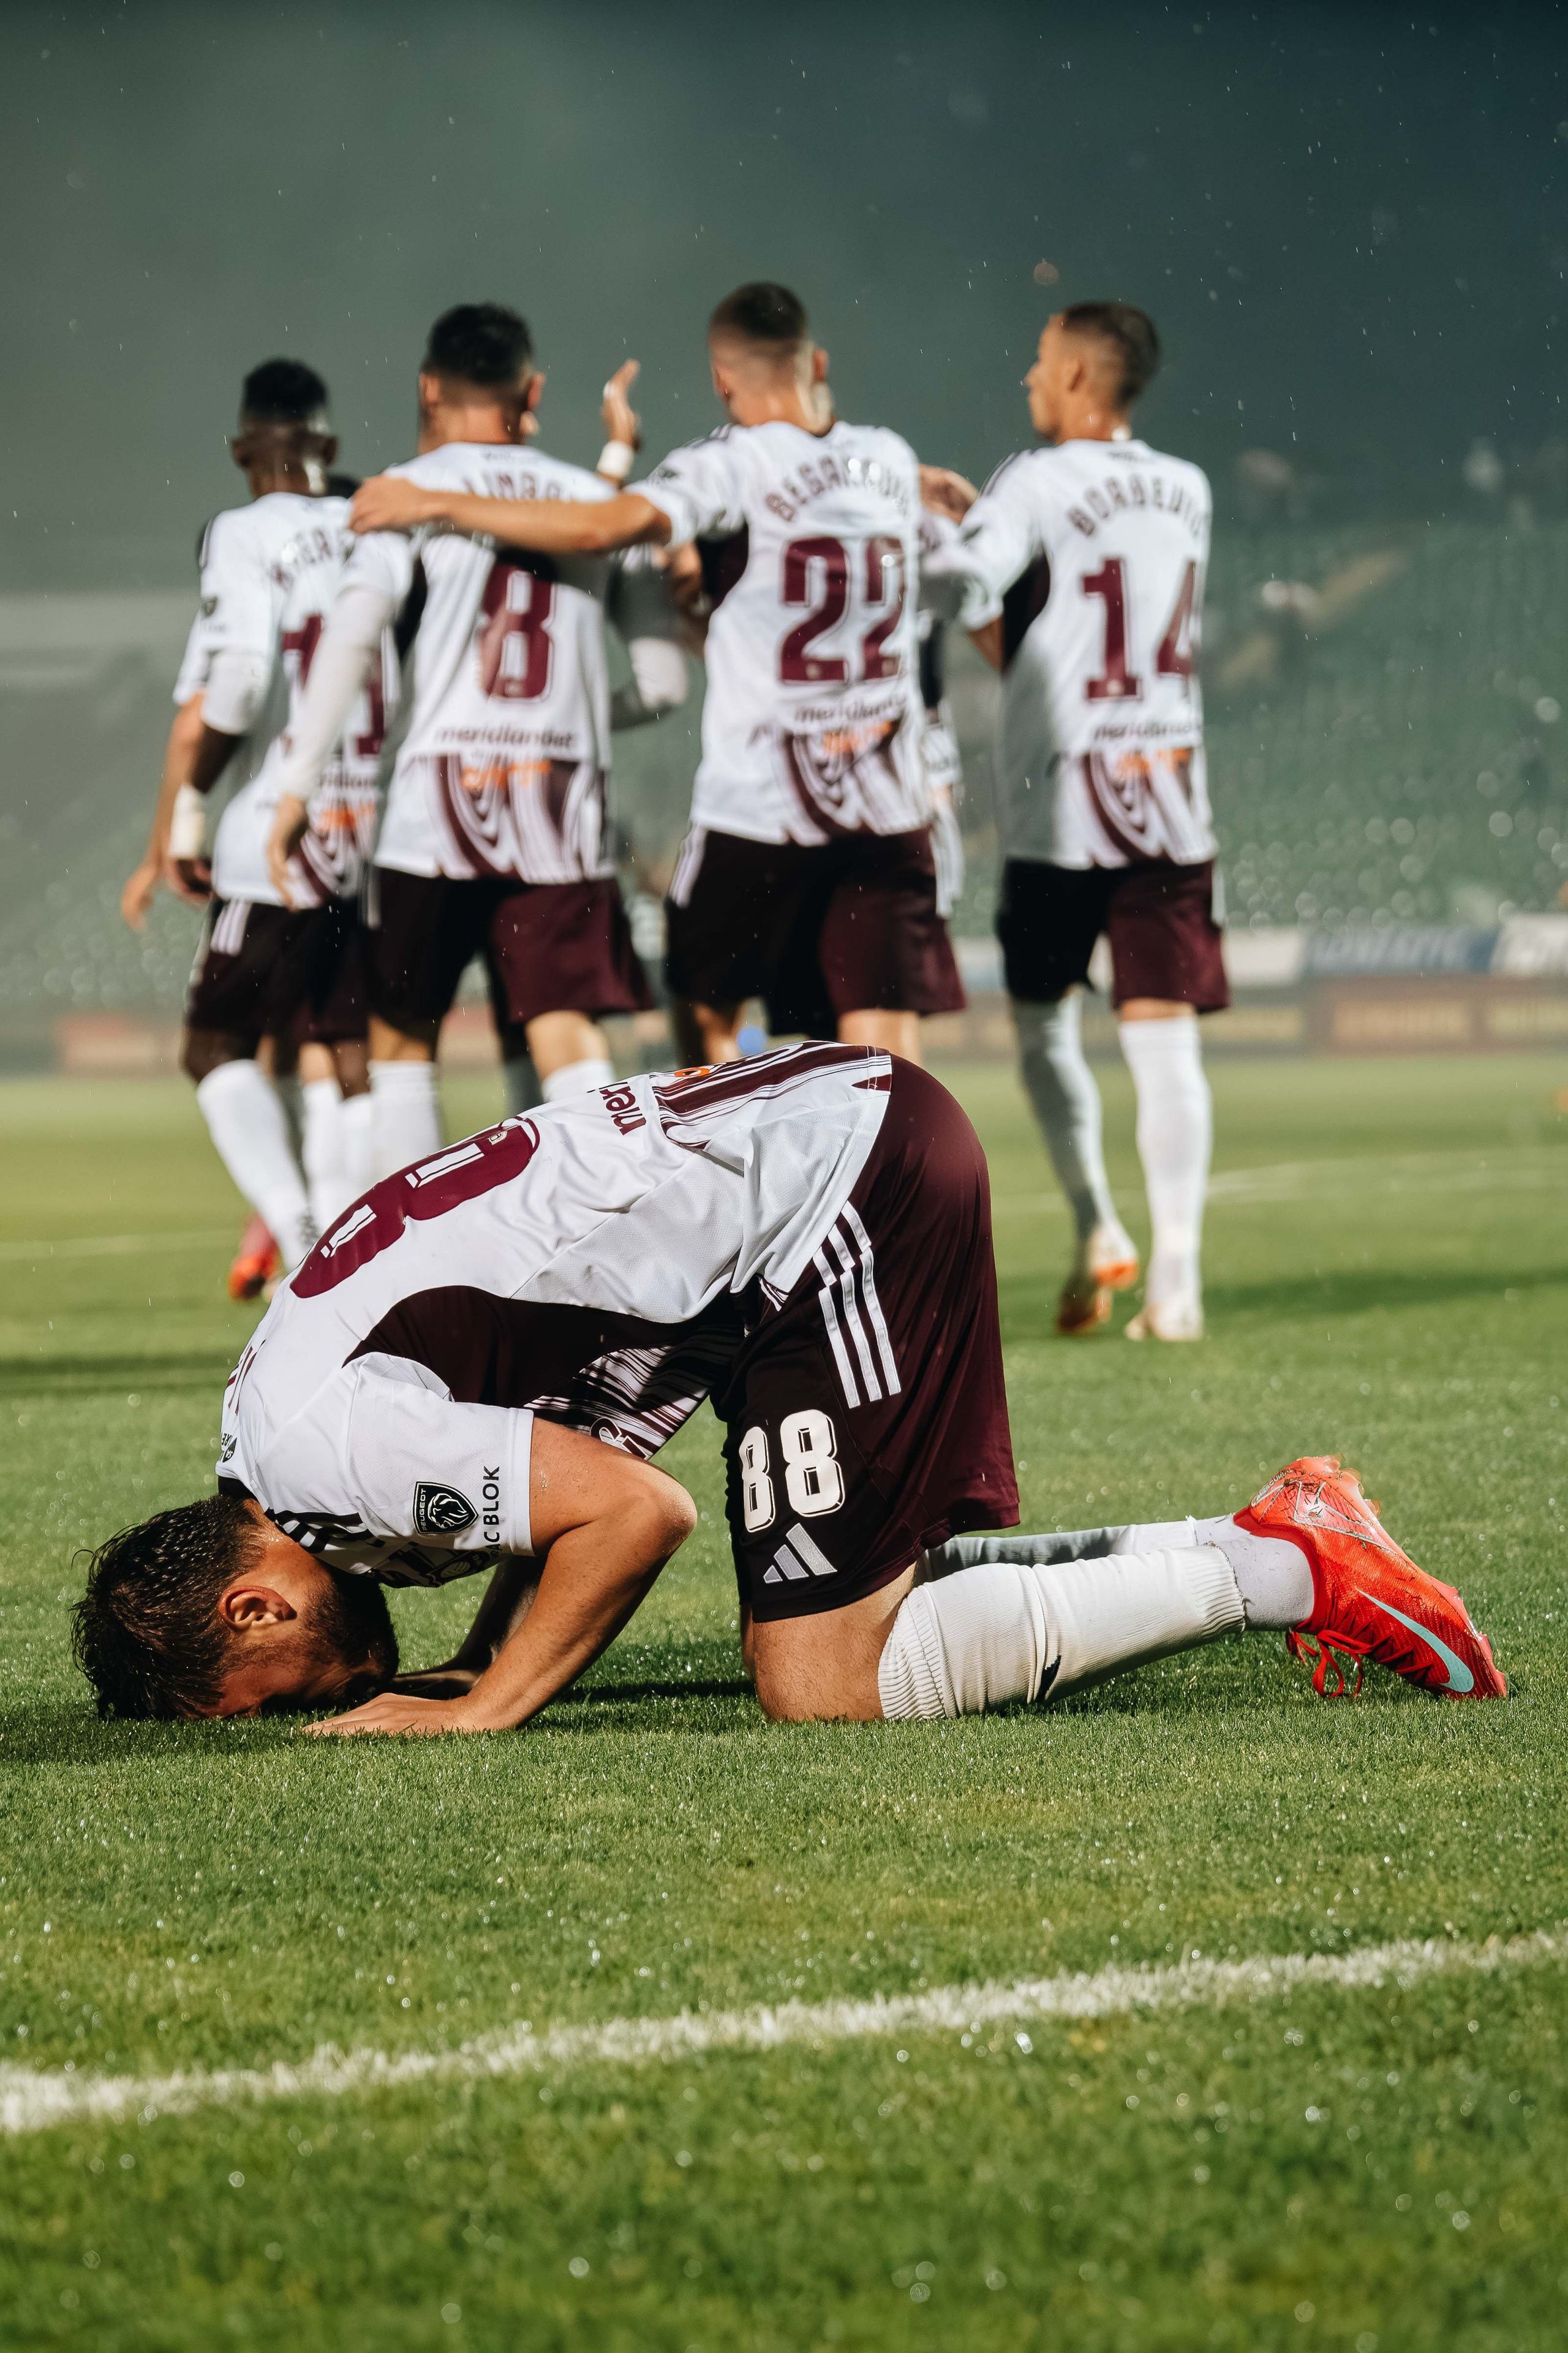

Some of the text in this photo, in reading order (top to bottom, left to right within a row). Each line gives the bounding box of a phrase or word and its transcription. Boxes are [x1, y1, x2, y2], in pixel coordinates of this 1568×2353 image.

[481, 560, 555, 702] 8
[779, 534, 907, 684] 22
[1082, 557, 1198, 702] 14
[483, 1466, 500, 1525] BLOK
[739, 1408, 845, 1533] 88
